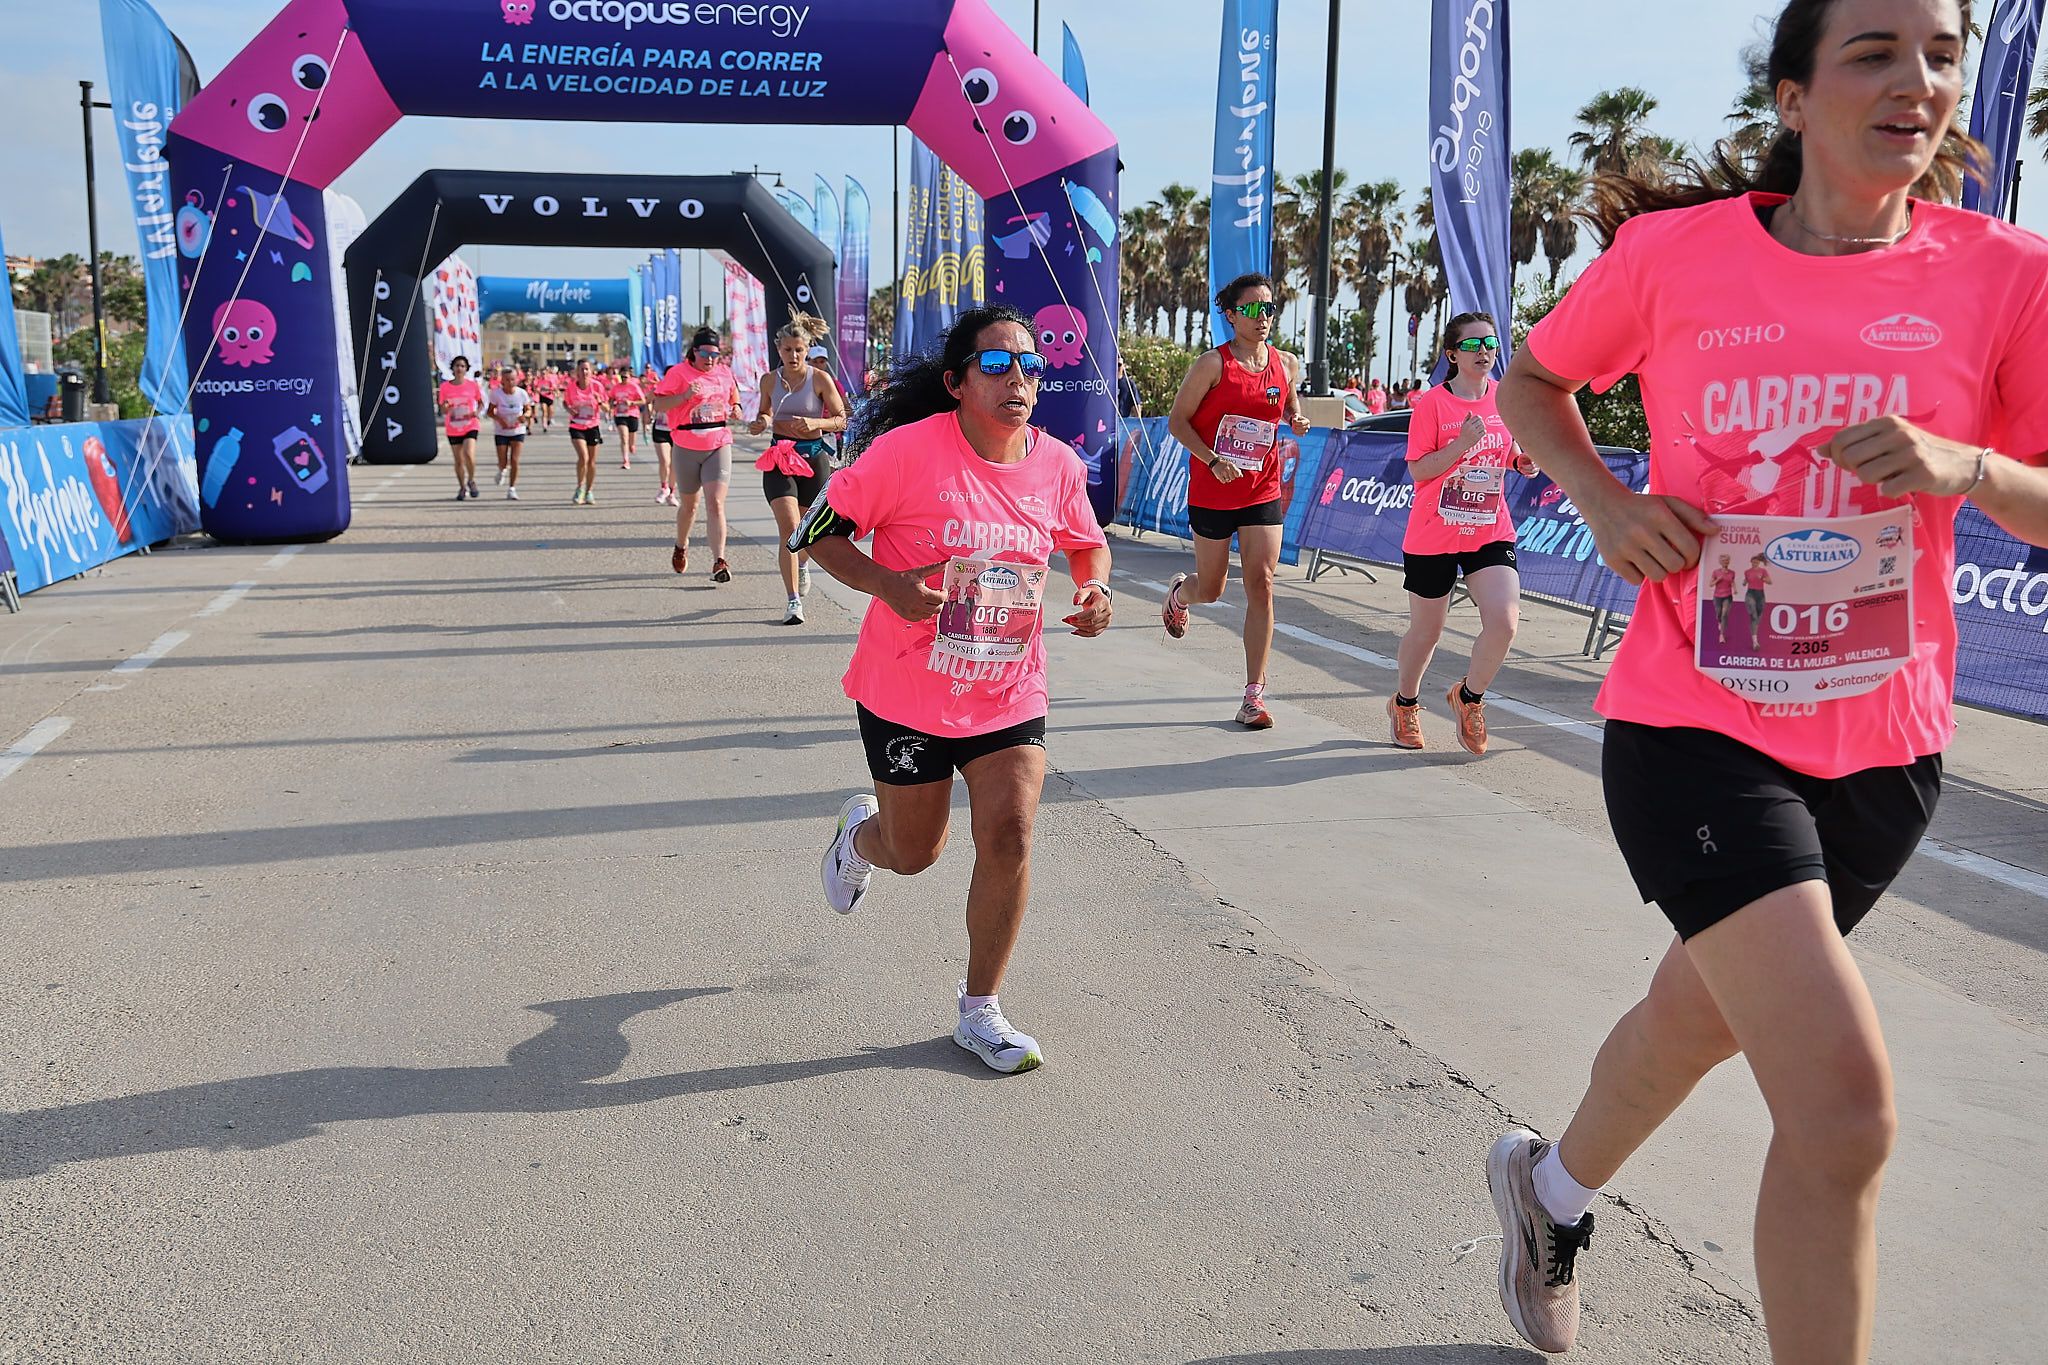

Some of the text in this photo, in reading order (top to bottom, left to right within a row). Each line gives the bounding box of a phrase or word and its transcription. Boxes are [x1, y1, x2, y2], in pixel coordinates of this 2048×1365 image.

[549, 0, 810, 37] octopus energy
[481, 42, 823, 71] LA ENERGÍA PARA CORRER
[479, 72, 828, 98] A LA VELOCIDAD DE LA LUZ
[479, 193, 705, 219] VOLVO
[525, 280, 592, 309] Marlene
[1697, 323, 1786, 351] OYSHO
[373, 281, 403, 441] VOLVO
[196, 377, 313, 397] octopus energy
[1065, 380, 1109, 395] energy
[1703, 373, 1910, 435] CARRERA
[1441, 421, 1464, 431] OYSH
[1233, 439, 1254, 451] 016
[939, 490, 984, 504] OYSHO
[1342, 476, 1413, 515] octopus
[1462, 491, 1485, 502] 016
[942, 518, 1041, 553] CARRERA
[1731, 525, 1760, 533] DORSAL
[1516, 516, 1596, 561] PARA TU
[1720, 533, 1761, 544] SUMA
[1773, 544, 1854, 562] ASTURIANA
[981, 573, 1016, 586] ASTURIANA
[975, 606, 1009, 624] 016
[1770, 602, 1849, 635] 016
[947, 631, 972, 641] CARRERA
[982, 626, 999, 635] 1880
[947, 641, 980, 656] OYSHO
[1791, 640, 1829, 655] 2305
[1719, 647, 1890, 669] CARRERA DE LA MUJER VALENCIA
[1721, 676, 1789, 693] OYSHO
[1830, 672, 1889, 688] Santander
